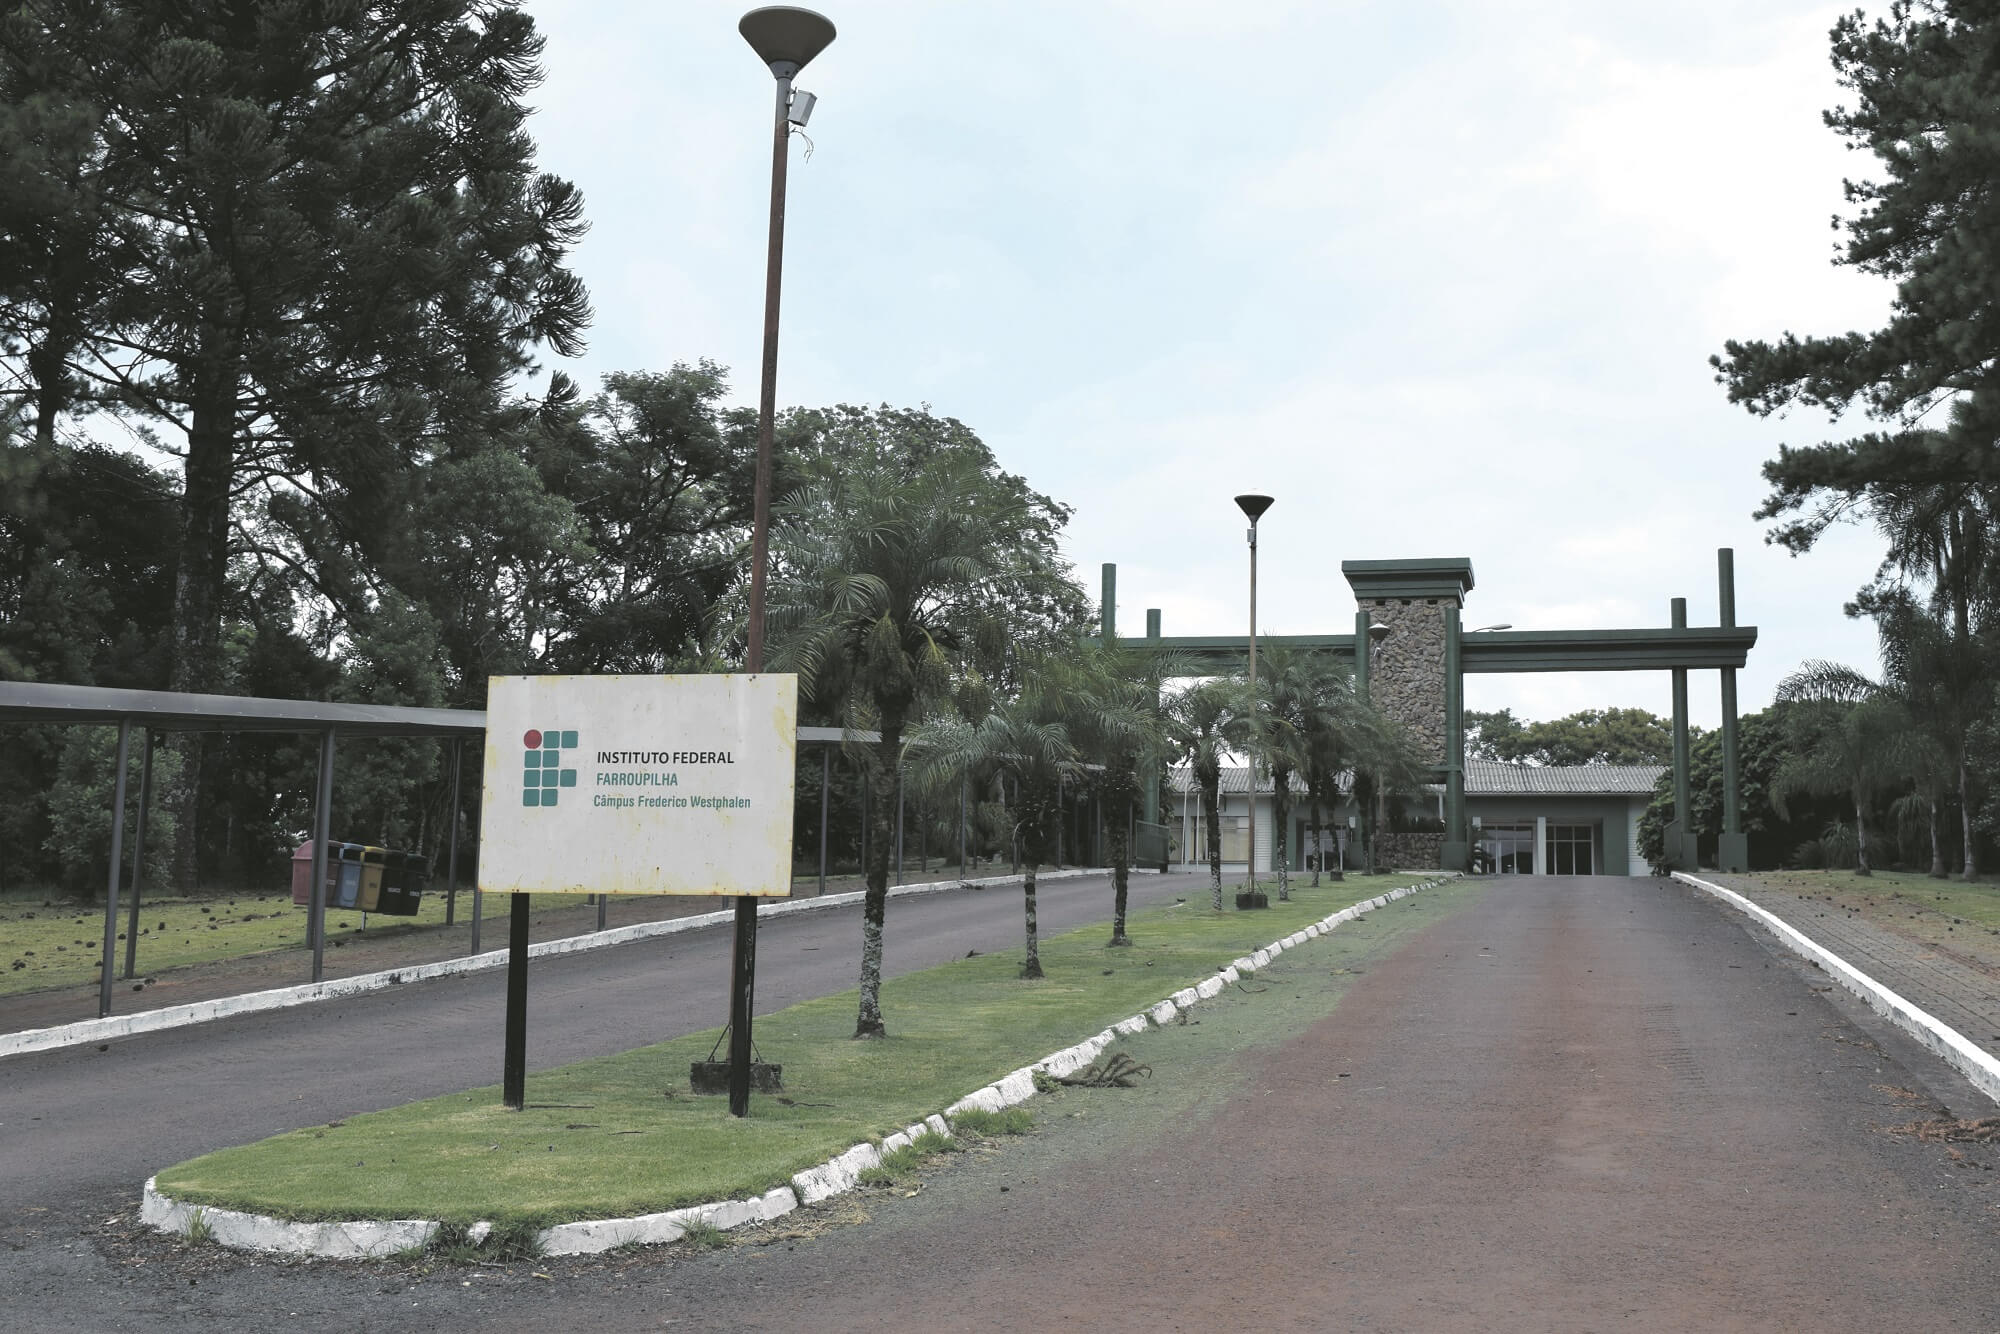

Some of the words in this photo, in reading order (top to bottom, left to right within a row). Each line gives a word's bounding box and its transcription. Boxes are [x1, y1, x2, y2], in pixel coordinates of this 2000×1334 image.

[597, 751, 669, 764] INSTITUTO
[672, 751, 735, 764] FEDERAL
[596, 772, 678, 786] FARROUPILHA
[593, 794, 635, 809] Câmpus
[637, 795, 687, 808] Frederico
[690, 795, 751, 811] Westphalen
